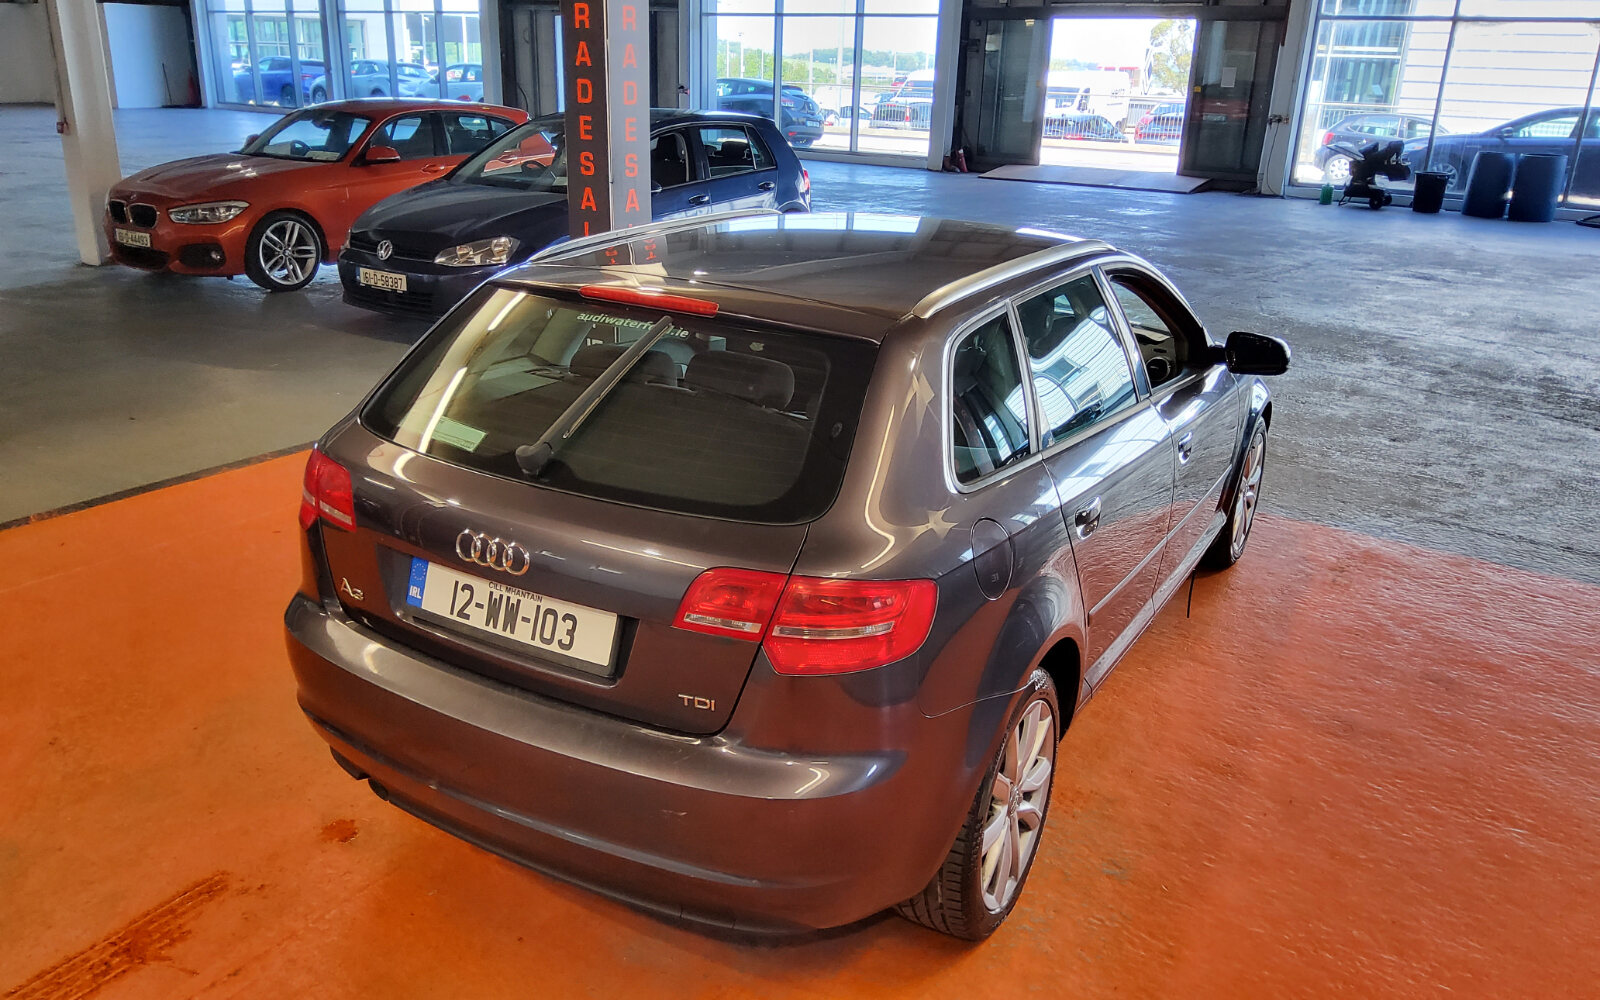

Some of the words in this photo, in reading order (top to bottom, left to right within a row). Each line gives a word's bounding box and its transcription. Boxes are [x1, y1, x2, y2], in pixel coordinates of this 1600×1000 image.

[622, 5, 640, 228] RADESA
[577, 313, 689, 338] audiwaterf.ie
[340, 577, 364, 601] A3
[409, 584, 422, 599] IRL
[488, 581, 504, 592] CILL
[504, 586, 543, 603] MHANTAIN
[450, 580, 578, 651] 12-WW-103
[678, 693, 715, 711] TDI
